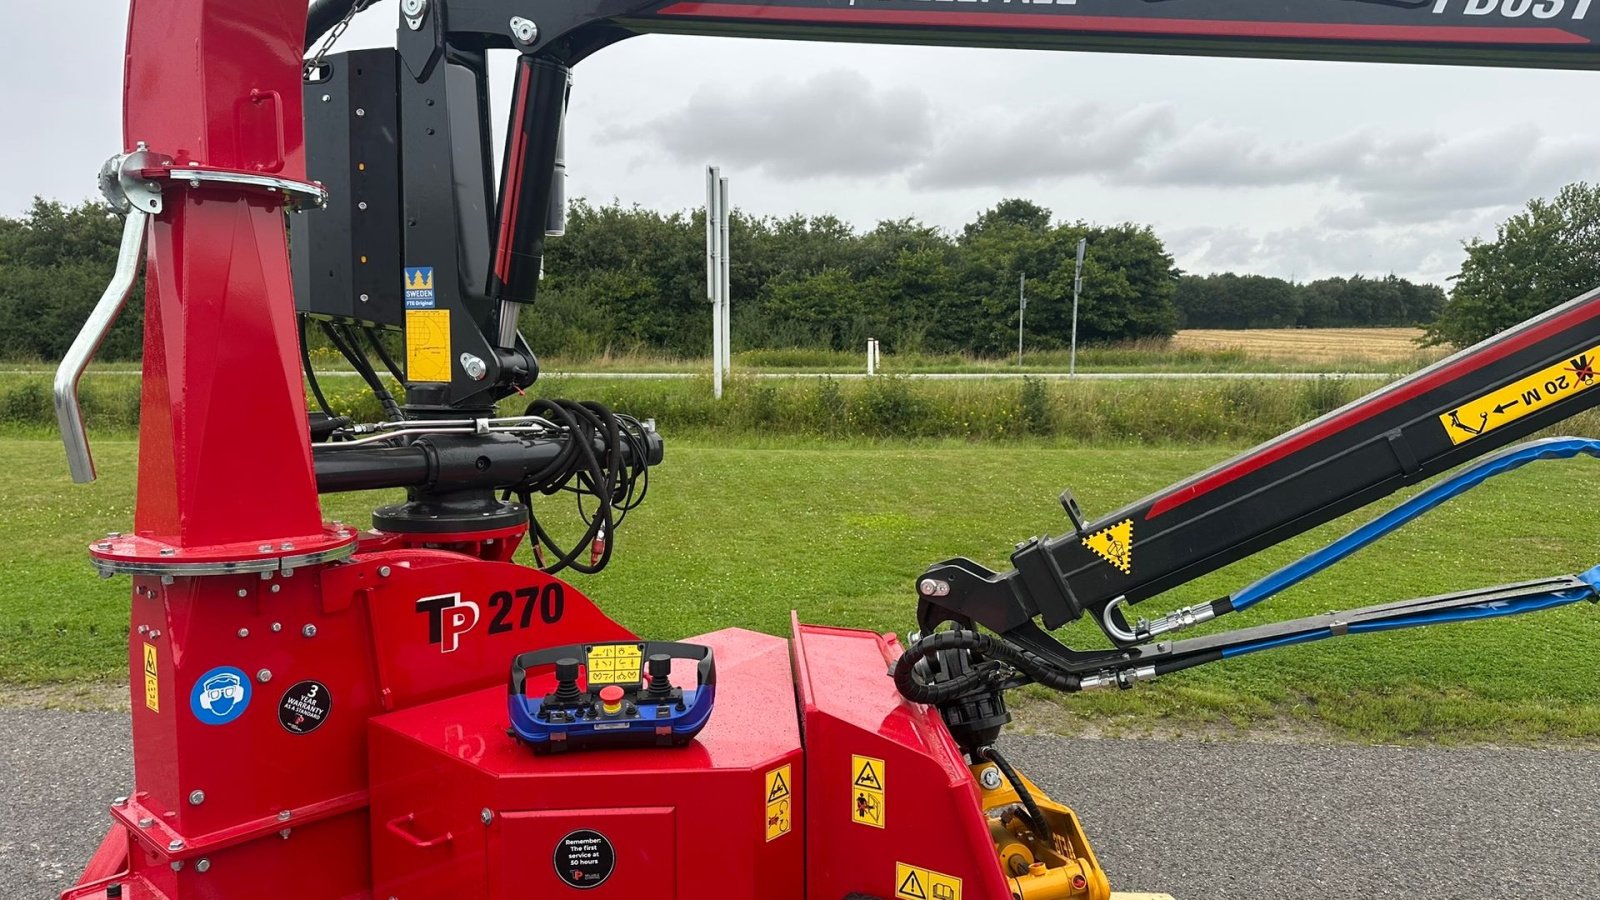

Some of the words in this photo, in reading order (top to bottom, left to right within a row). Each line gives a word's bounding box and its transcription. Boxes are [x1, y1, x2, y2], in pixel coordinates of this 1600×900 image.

[405, 290, 433, 298] SWEDEN
[1544, 375, 1570, 395] 20
[1521, 388, 1542, 406] M
[416, 592, 480, 653] TP
[487, 582, 565, 635] 270
[307, 684, 319, 698] 3
[287, 696, 324, 715] WARRANTY
[301, 694, 317, 706] YEAR
[295, 707, 321, 720] STANDARD
